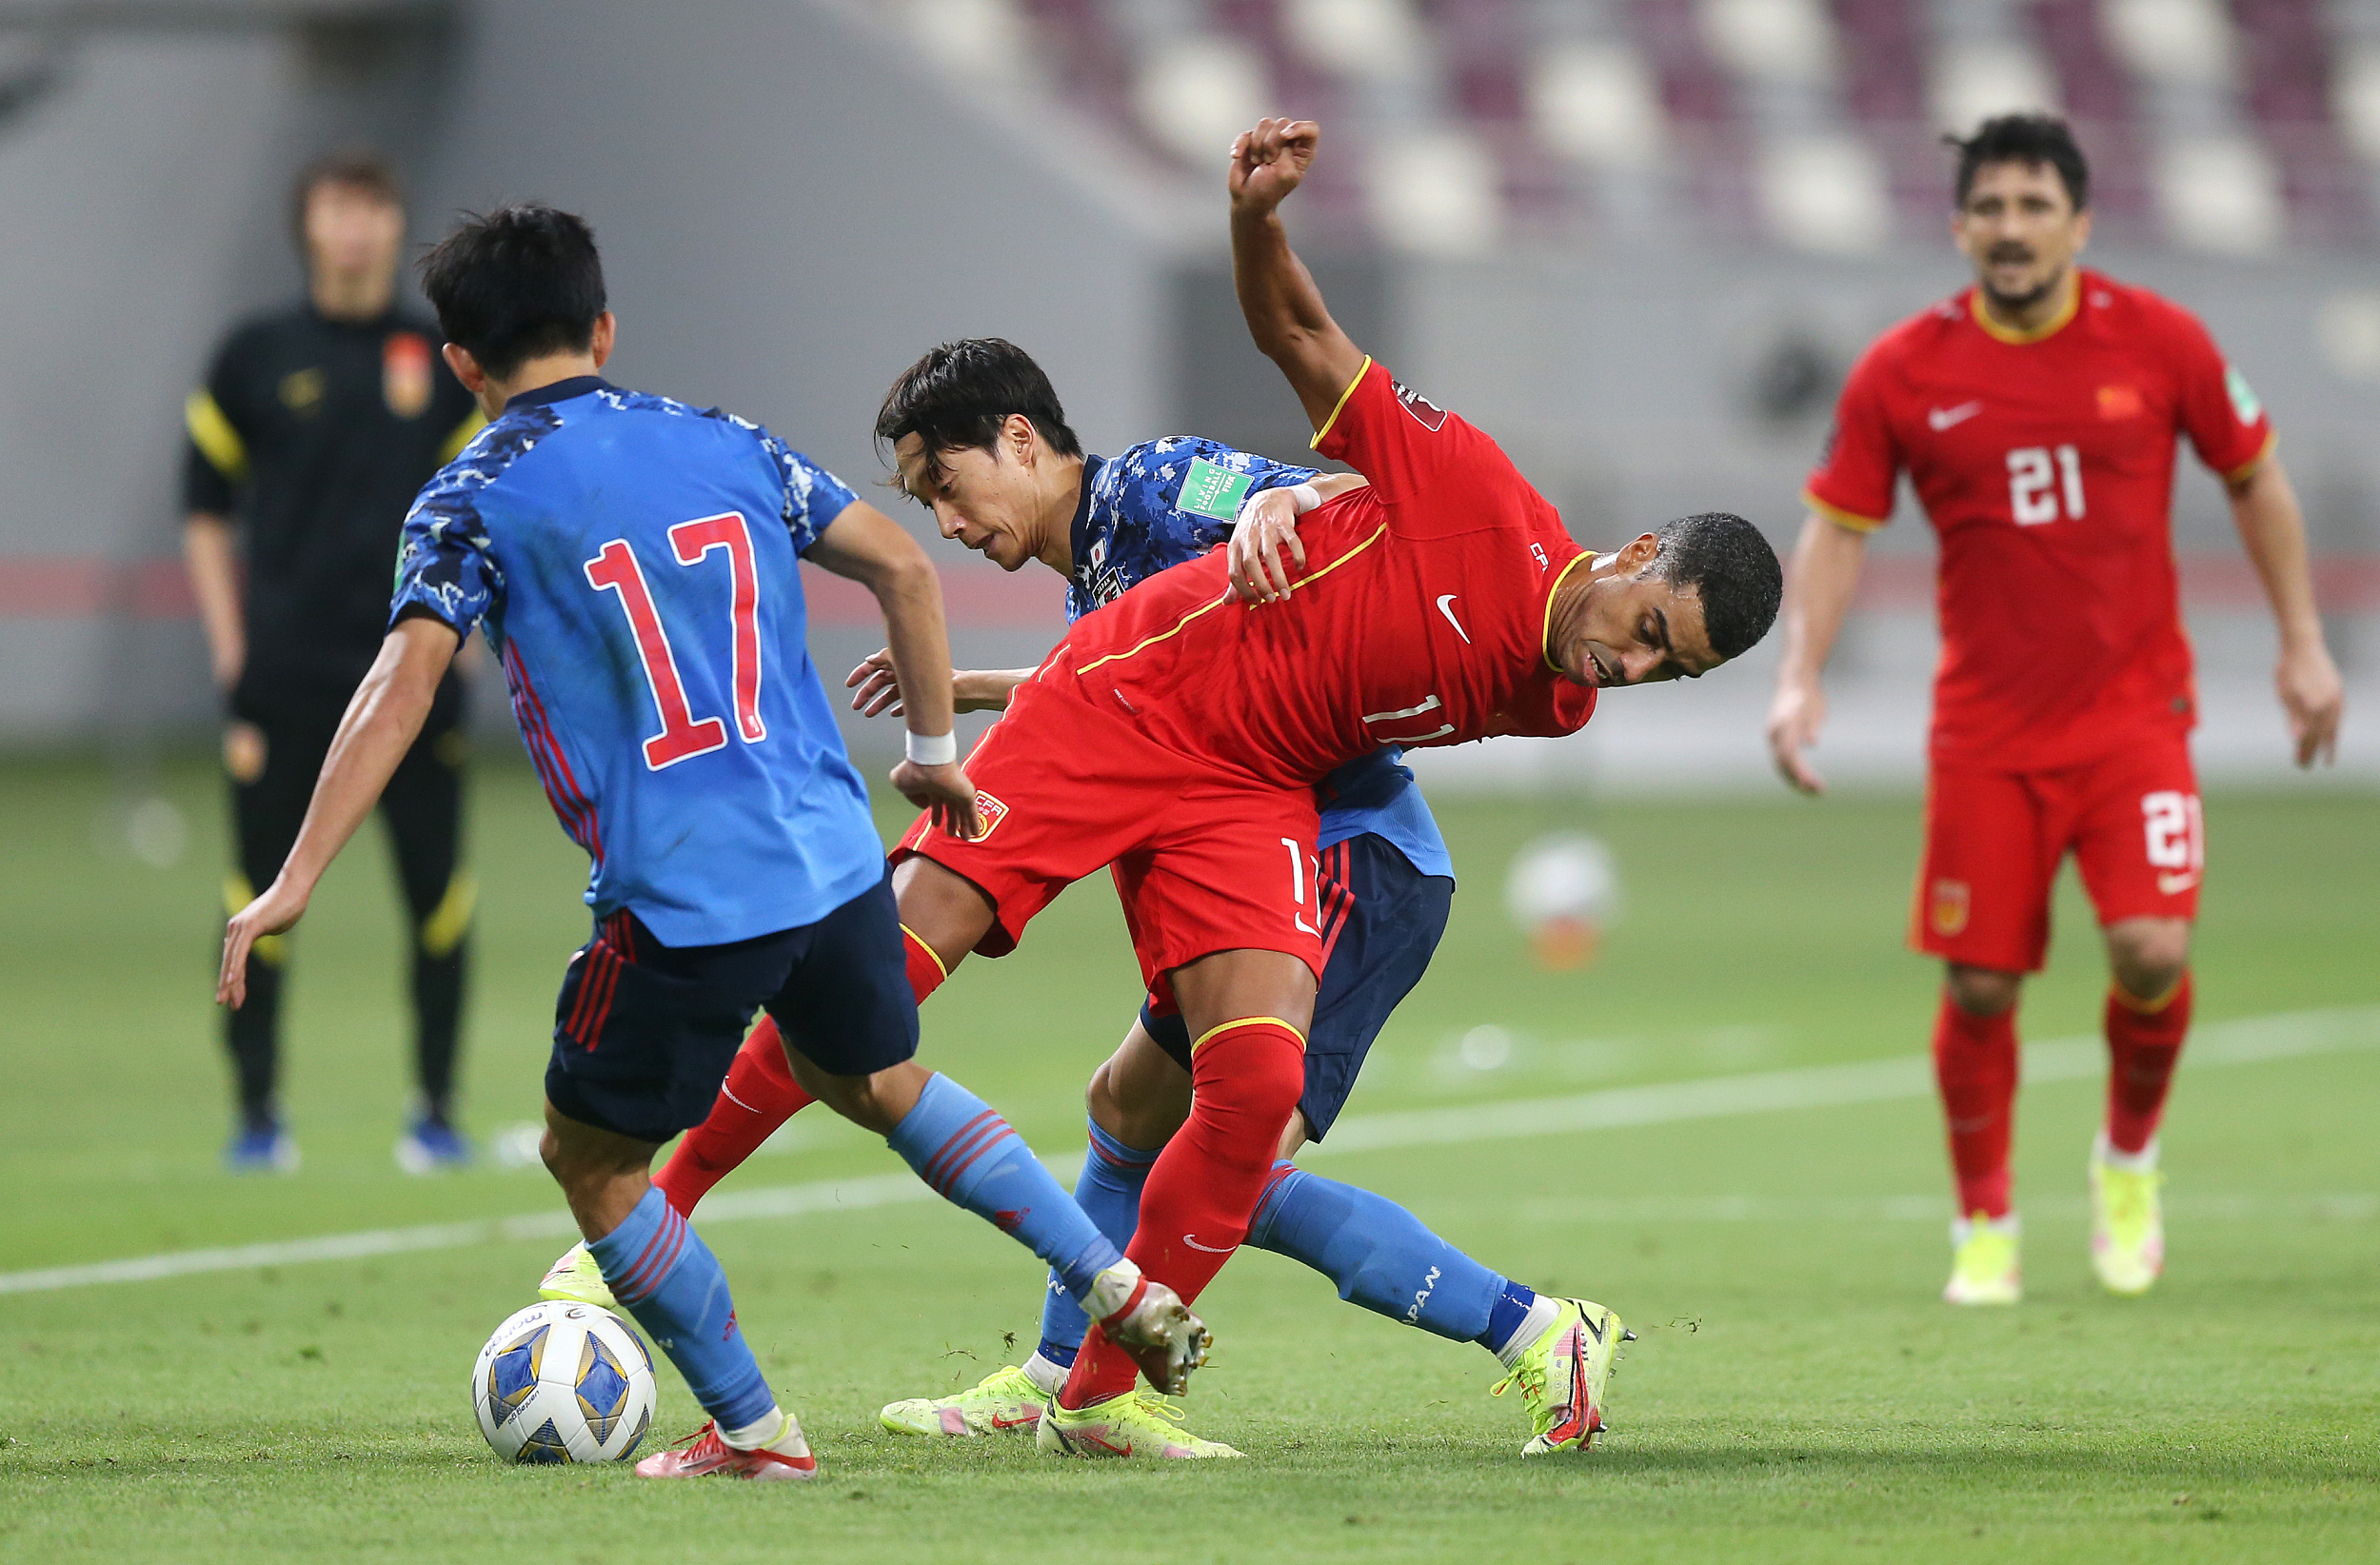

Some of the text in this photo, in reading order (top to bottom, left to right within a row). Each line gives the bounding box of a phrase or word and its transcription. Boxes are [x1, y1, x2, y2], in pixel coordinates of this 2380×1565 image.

[1193, 467, 1216, 509] LIVING
[1200, 470, 1222, 511] FOOTBALL
[1221, 474, 1237, 493] FIFA
[2006, 443, 2085, 527] 21
[1097, 577, 1111, 595] JAPAN
[584, 511, 767, 772] 17
[1361, 693, 1456, 743] 11
[975, 795, 1003, 817] CFA
[2141, 789, 2205, 874] 21
